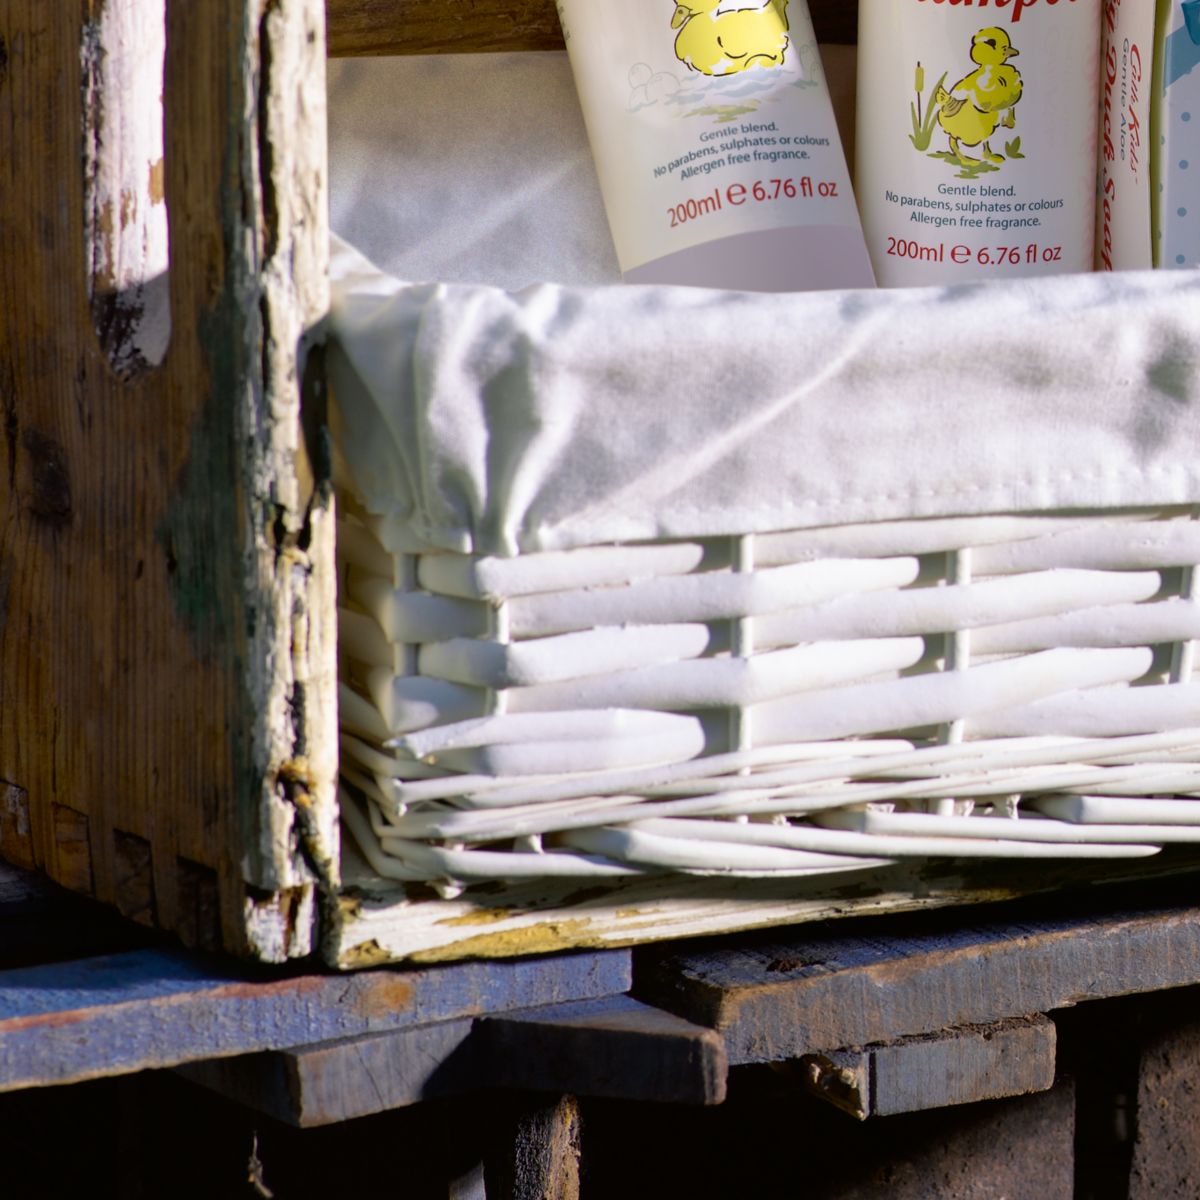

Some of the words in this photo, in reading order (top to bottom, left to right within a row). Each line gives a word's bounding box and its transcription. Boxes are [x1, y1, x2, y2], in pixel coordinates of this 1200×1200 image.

[1121, 37, 1130, 107] Gentle
[1130, 43, 1142, 104] Cath
[1103, 39, 1117, 161] Duck
[699, 126, 739, 142] Gentle
[741, 121, 779, 134] blend.
[653, 166, 668, 178] No
[668, 145, 719, 173] parabens,
[720, 135, 777, 153] sulphates
[779, 136, 791, 145] or
[793, 135, 830, 146] colours
[680, 158, 726, 181] Allergen
[728, 152, 751, 164] free
[753, 149, 810, 163] fragrance.
[667, 188, 722, 228] 200ml
[752, 178, 797, 201] 6.76
[800, 176, 814, 198] fl
[818, 182, 839, 197] oz
[885, 190, 899, 203] No
[900, 196, 953, 212] parabens,
[955, 200, 1011, 214] sulphates
[1014, 202, 1026, 212] or
[1028, 198, 1064, 211] colours
[937, 183, 977, 197] Gentle
[979, 185, 1016, 197] blend.
[910, 211, 957, 227] Allergen
[960, 216, 983, 228] free
[986, 216, 1042, 230] fragrance.
[886, 237, 944, 262] 200ml
[977, 247, 1021, 265] 6.76
[1025, 244, 1037, 263] fl
[1042, 246, 1062, 262] oz
